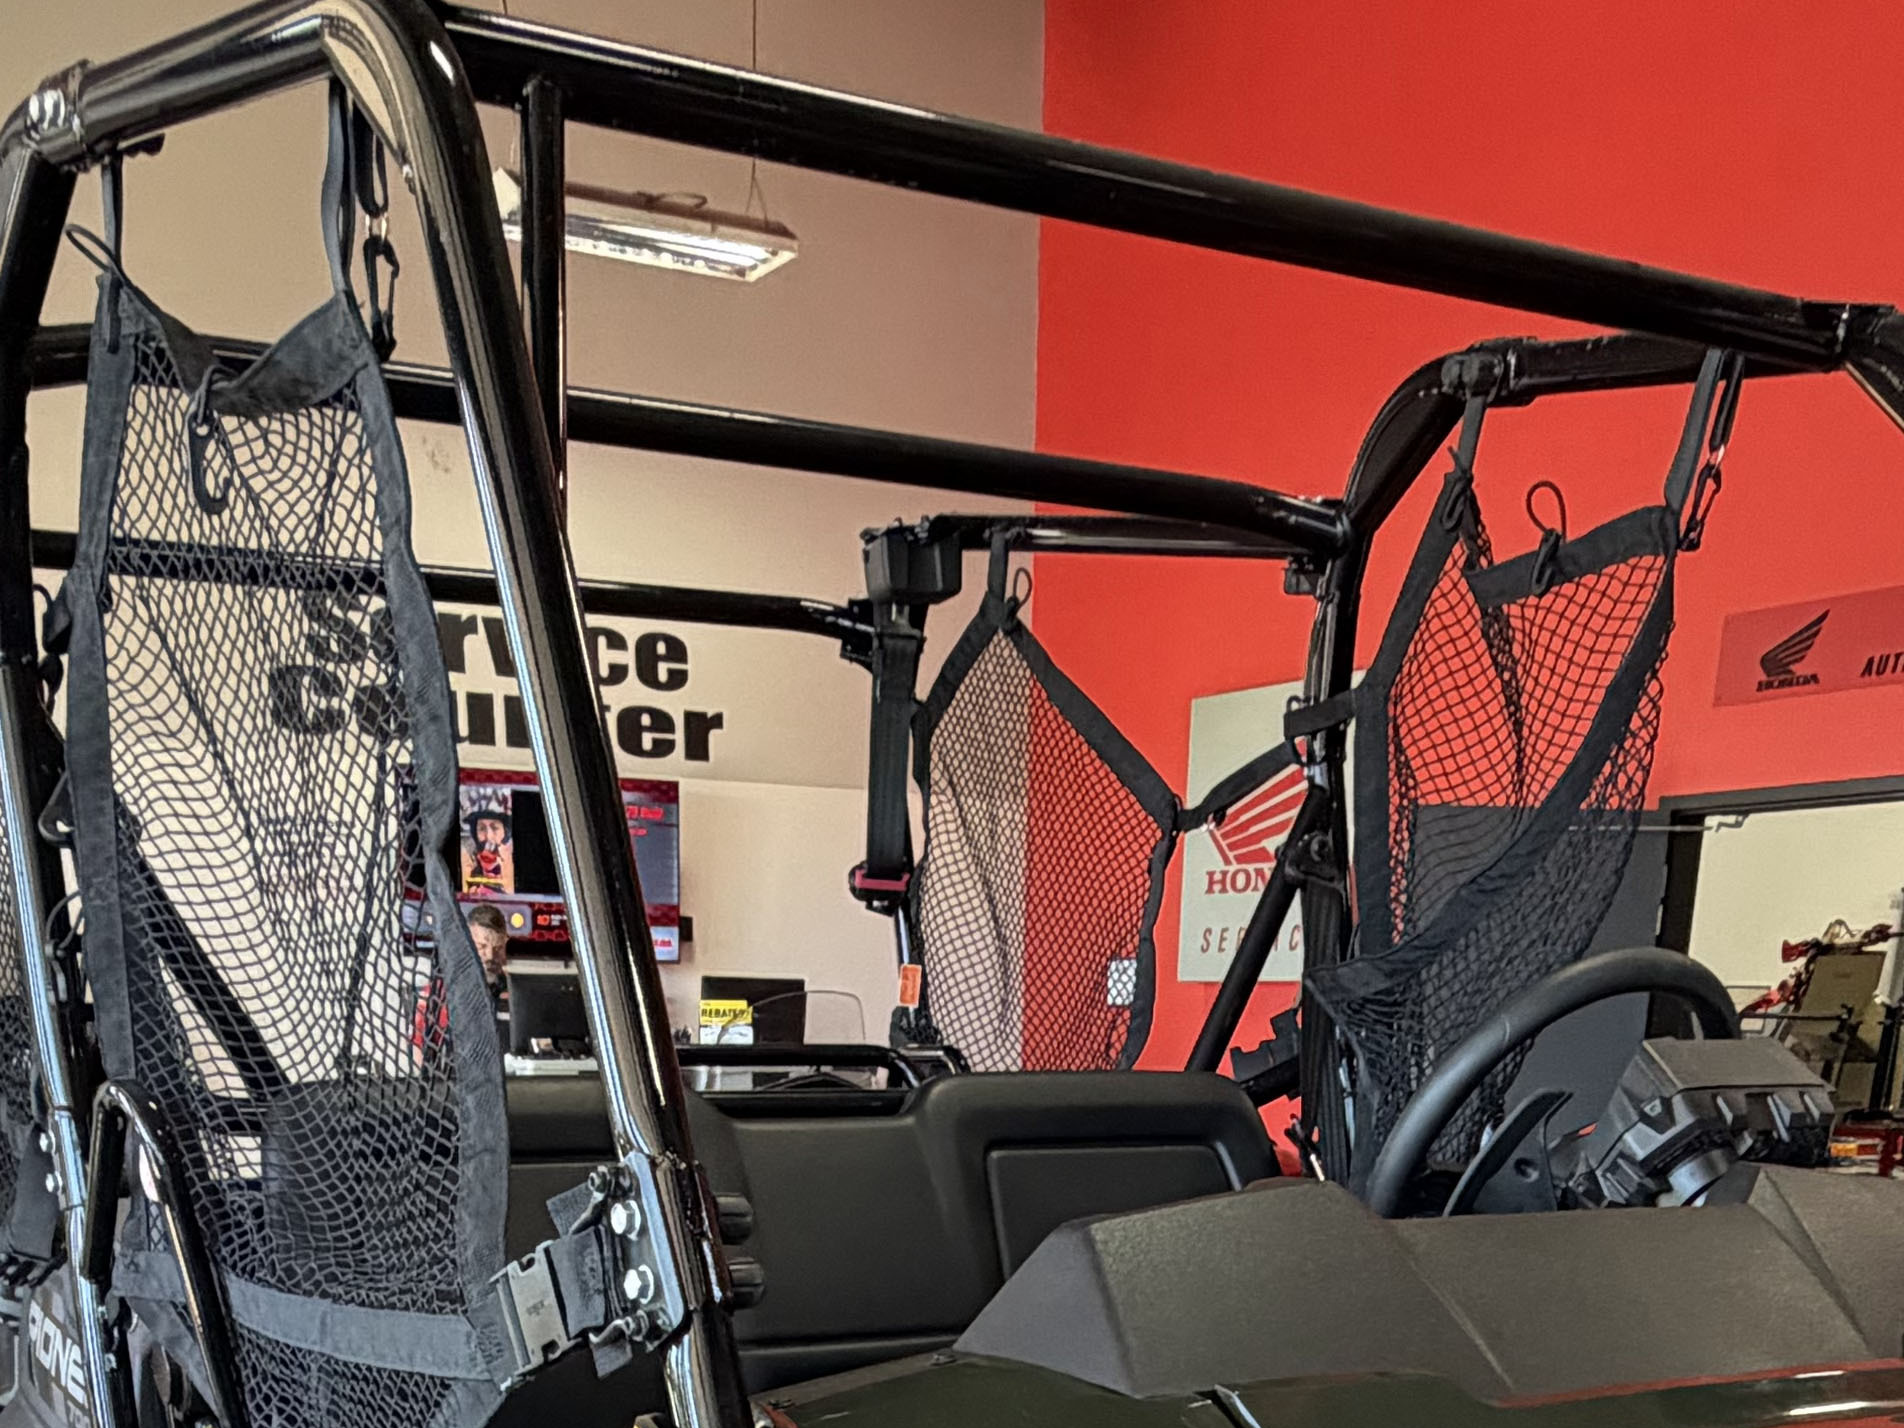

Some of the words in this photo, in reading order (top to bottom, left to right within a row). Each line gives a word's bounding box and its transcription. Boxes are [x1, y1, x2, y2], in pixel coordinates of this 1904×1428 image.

[304, 588, 689, 691] Srvce
[270, 664, 723, 762] Couer
[1205, 867, 1275, 895] HON
[1201, 924, 1301, 953] SEIC
[28, 1300, 88, 1409] PIONE
